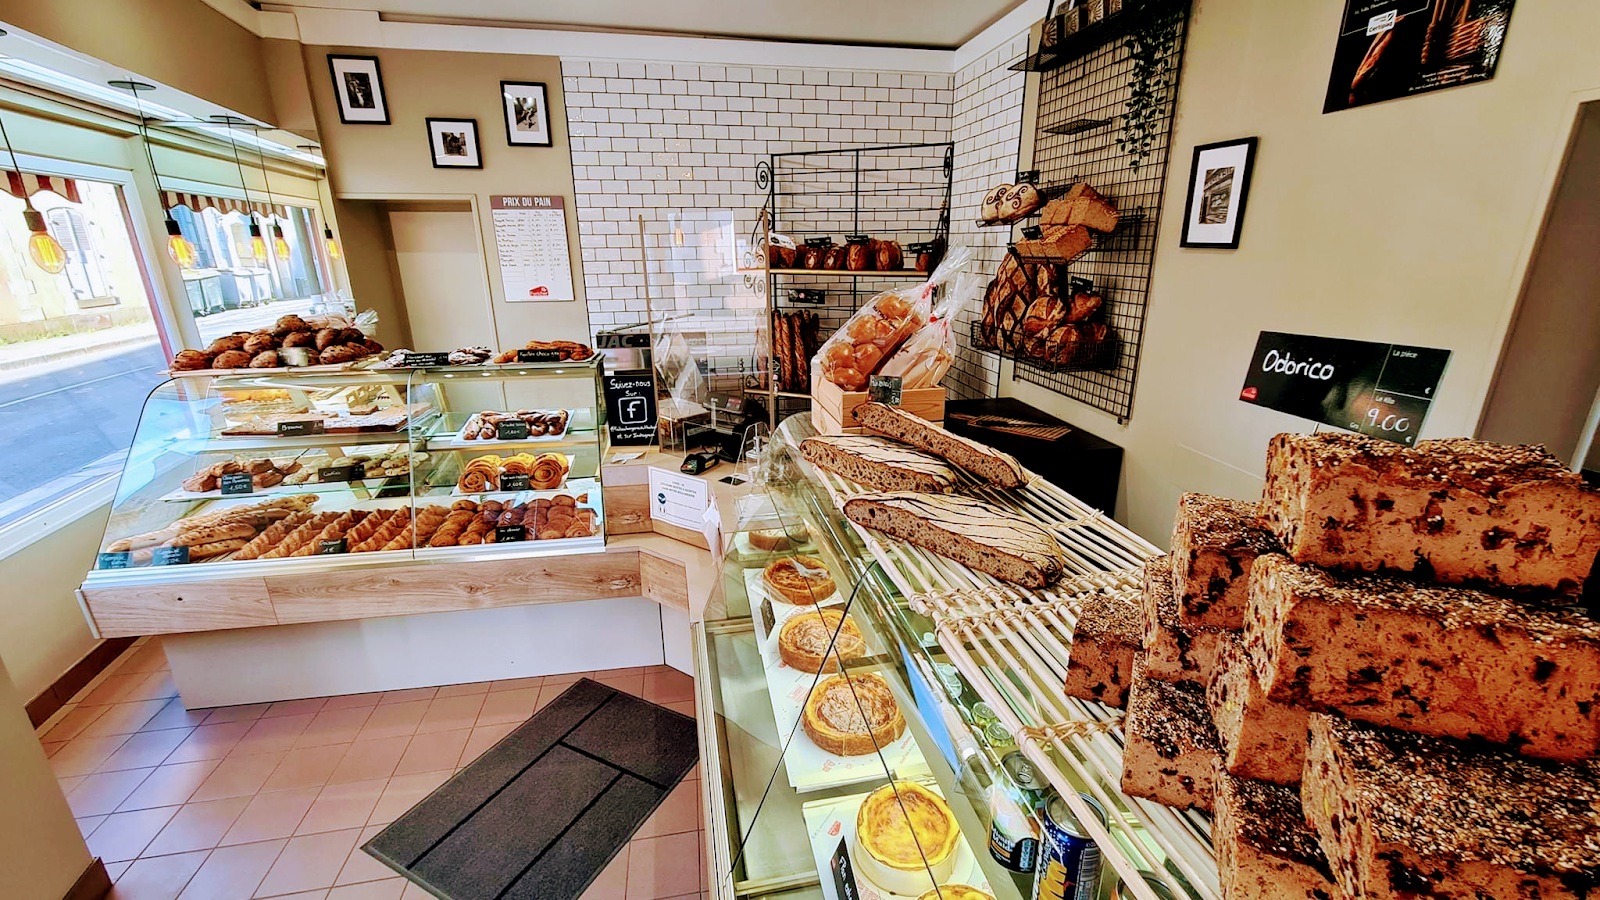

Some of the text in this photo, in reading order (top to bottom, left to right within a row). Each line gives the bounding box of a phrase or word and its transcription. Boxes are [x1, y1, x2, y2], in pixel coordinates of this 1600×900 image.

[503, 197, 552, 207] PRIX DU PAIN
[598, 335, 634, 348] JAC
[1262, 349, 1335, 381] Odorico
[609, 378, 651, 390] Suivez-nous
[1367, 408, 1410, 432] 9.00
